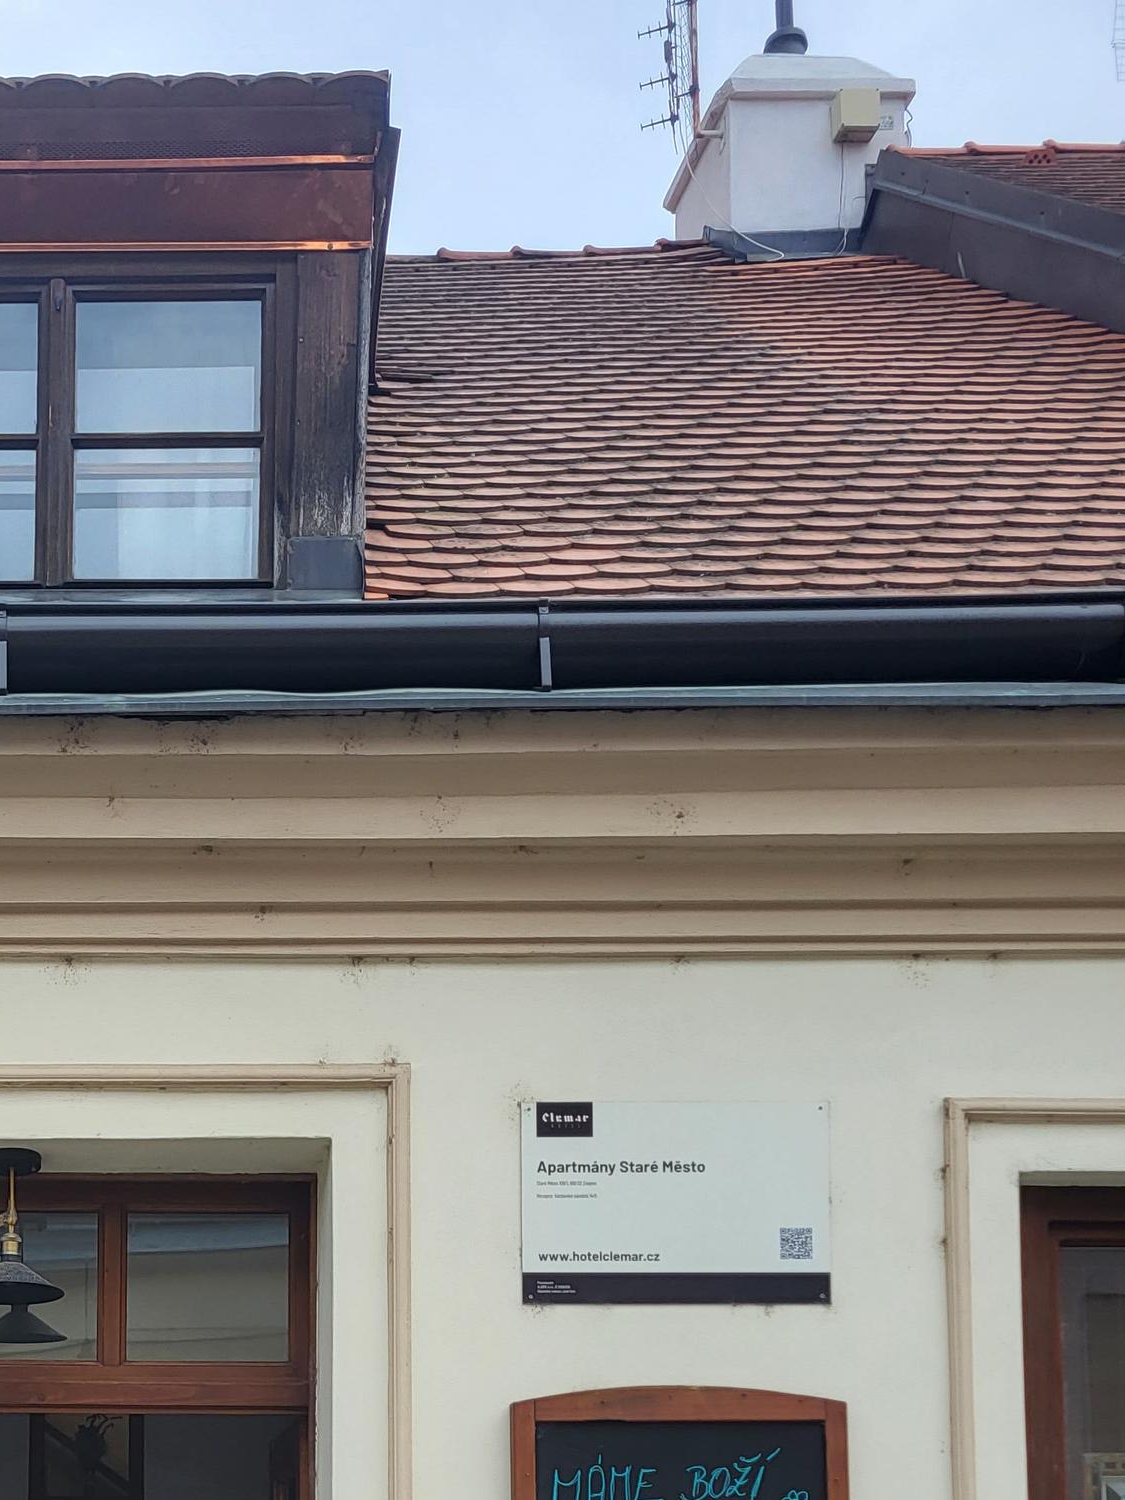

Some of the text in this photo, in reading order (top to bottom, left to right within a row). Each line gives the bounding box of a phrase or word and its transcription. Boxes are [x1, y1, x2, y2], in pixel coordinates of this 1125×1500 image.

[542, 1112, 589, 1122] Clemar
[537, 1160, 706, 1176] Apartmány Staré Město
[538, 1251, 660, 1263] www.hotelclemar.cz
